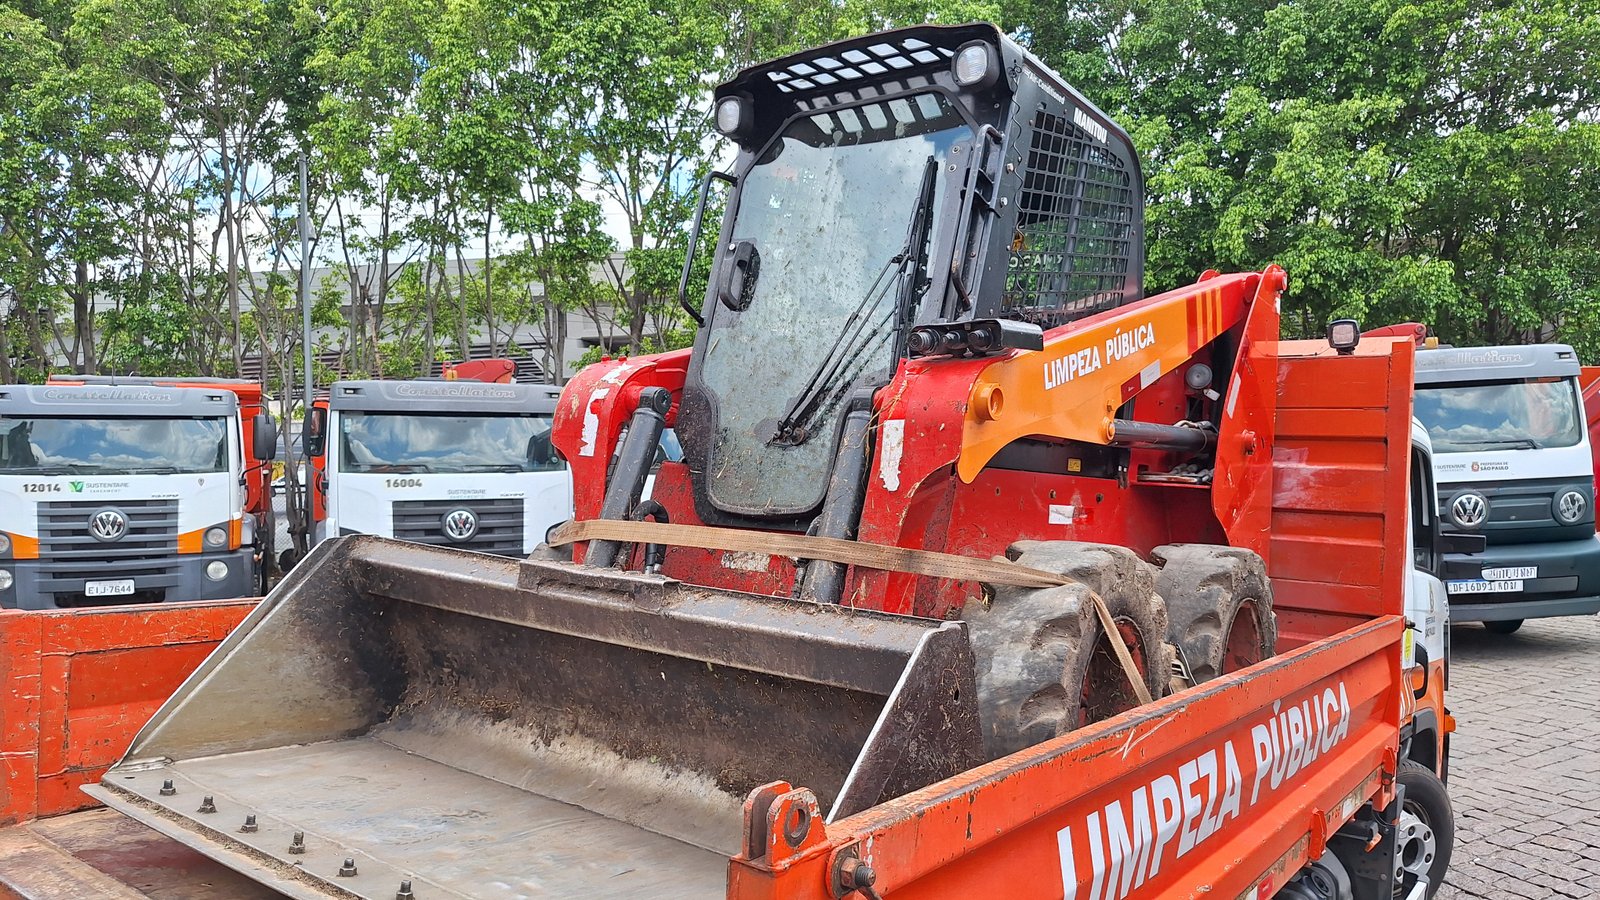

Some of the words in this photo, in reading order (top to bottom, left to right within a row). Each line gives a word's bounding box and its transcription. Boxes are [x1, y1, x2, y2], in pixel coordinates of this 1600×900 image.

[1074, 107, 1108, 144] MANITOU
[1043, 345, 1102, 390] LIMPEZA
[1105, 322, 1155, 364] PÚBLICA
[43, 389, 172, 401] Constellation
[396, 384, 516, 398] Constellation
[23, 483, 61, 493] 12014
[385, 478, 422, 488] 16004
[1057, 740, 1242, 900] LIMPEZA
[1250, 681, 1351, 806] PÚBLICA
